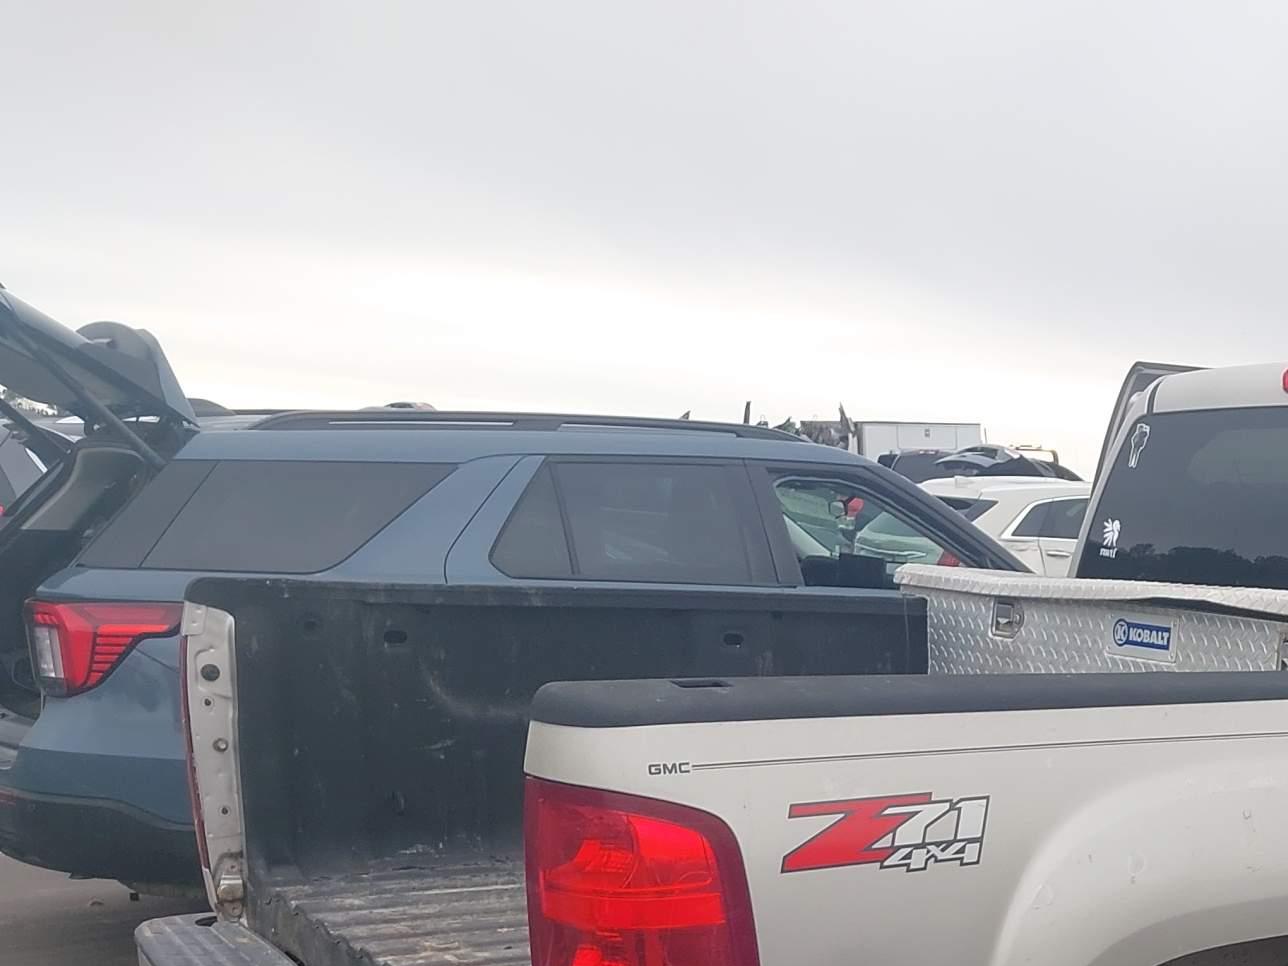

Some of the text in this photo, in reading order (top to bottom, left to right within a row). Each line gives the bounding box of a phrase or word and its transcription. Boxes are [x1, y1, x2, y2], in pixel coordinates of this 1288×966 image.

[1129, 628, 1170, 645] KOBALT
[648, 762, 691, 775] GMC
[780, 792, 990, 873] Z71
